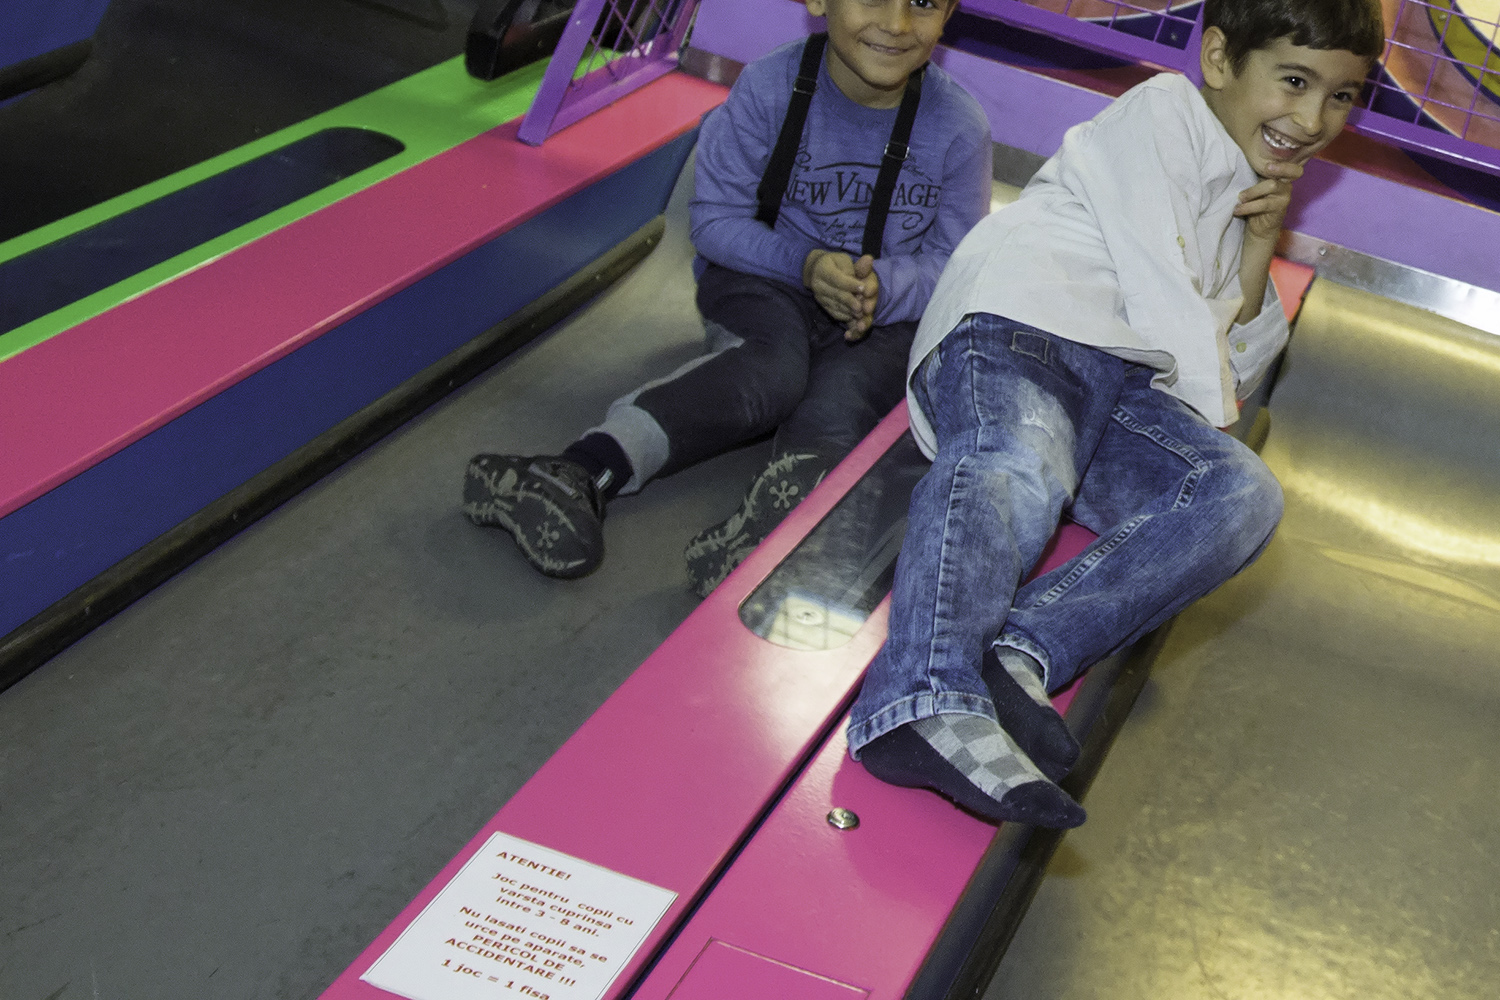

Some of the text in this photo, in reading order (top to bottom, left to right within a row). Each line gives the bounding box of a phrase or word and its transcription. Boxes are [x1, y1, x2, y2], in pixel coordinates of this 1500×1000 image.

[836, 171, 941, 209] VINAGE
[496, 851, 572, 881] ATENTIE!
[491, 873, 634, 926] Joc pentru copii cu
[496, 896, 532, 914] intre
[535, 910, 546, 918] 3
[560, 918, 571, 926] 8
[573, 923, 600, 938] ani.
[500, 887, 613, 930] varsta cuprinsa
[459, 906, 608, 963] Nu lasati copii sa se
[464, 920, 586, 969] urce pe aparate,
[472, 934, 566, 972] PERICOL DE
[441, 958, 452, 968] 1
[453, 963, 483, 978] joc
[504, 980, 515, 990] 1
[519, 985, 550, 1000] fisa
[444, 937, 577, 988] ACCIDENTARE !!!
